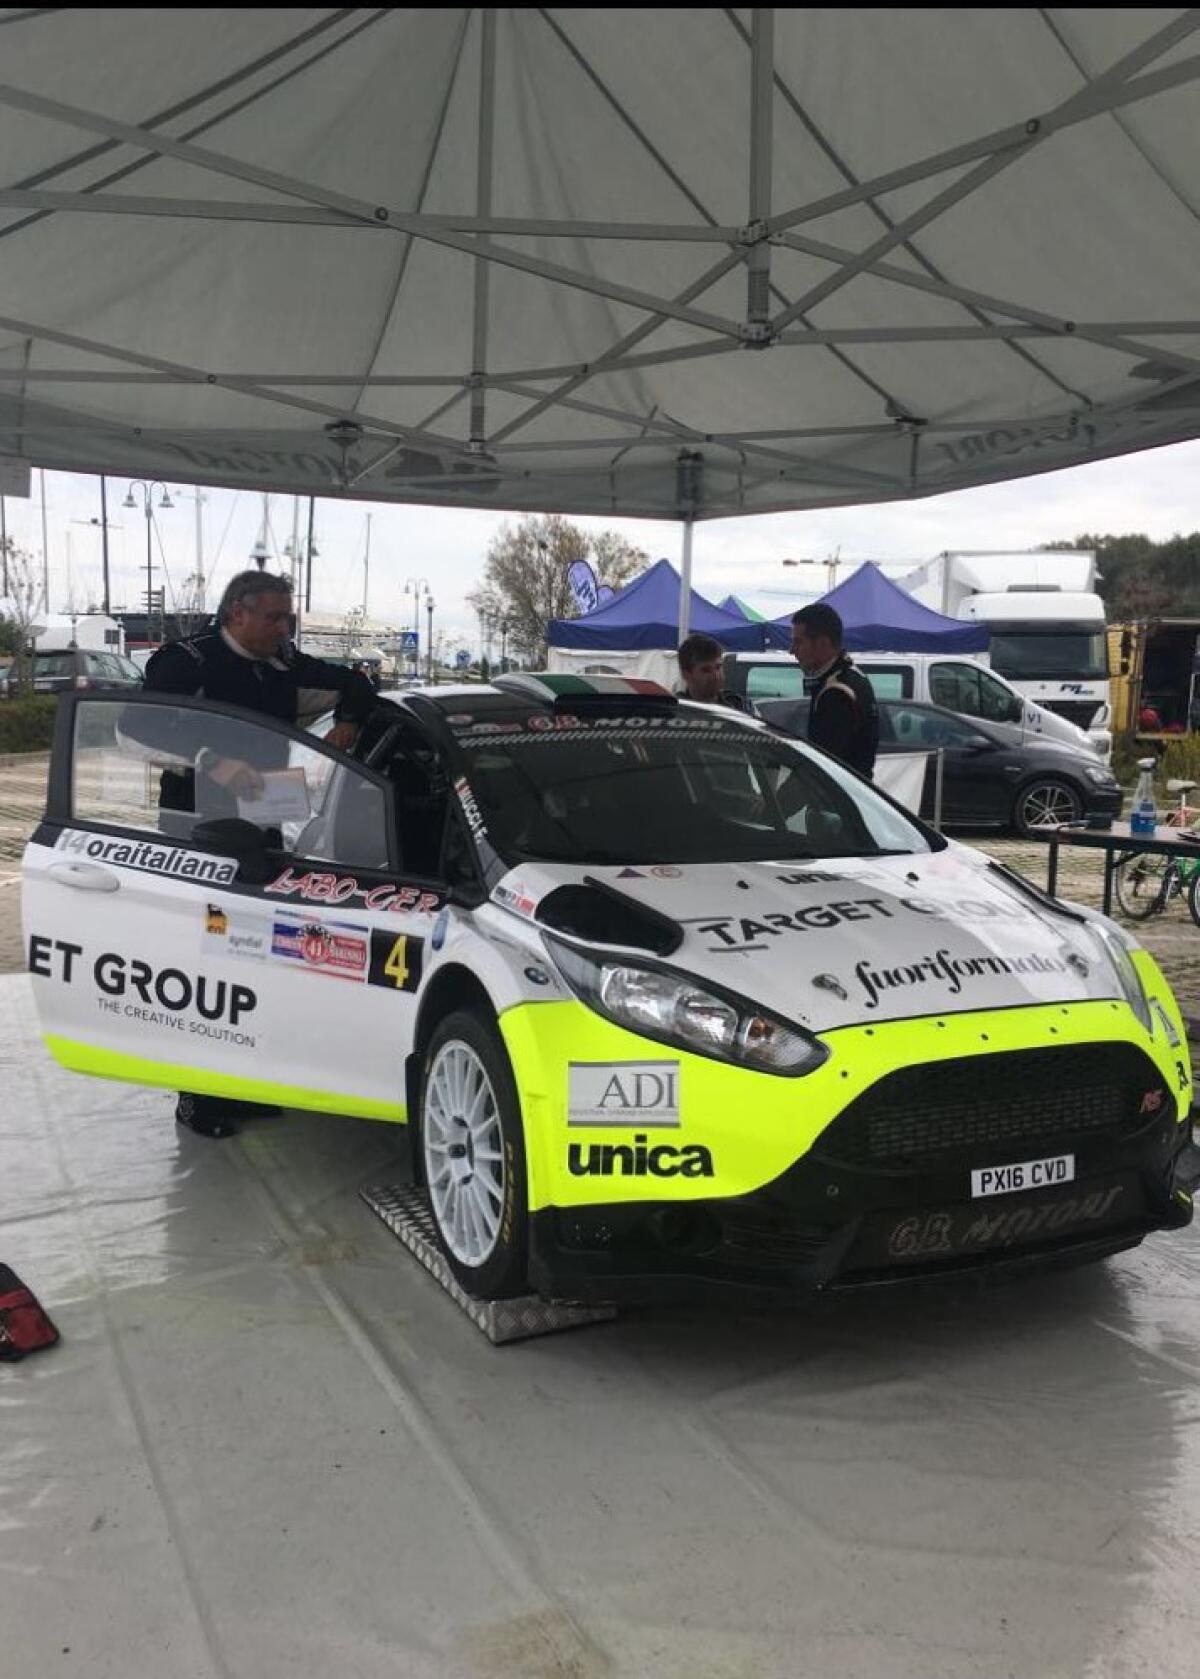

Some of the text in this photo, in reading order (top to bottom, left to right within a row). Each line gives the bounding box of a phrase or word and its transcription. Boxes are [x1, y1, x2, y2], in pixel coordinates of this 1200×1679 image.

[698, 899, 894, 946] TARGET
[28, 934, 258, 1026] ET GROUP
[384, 935, 409, 988] 4
[855, 949, 1065, 1008] fuoriformato
[98, 998, 256, 1048] THE CREATIVE SOLUTION
[598, 1073, 677, 1109] ADI
[568, 1134, 714, 1178] unica
[981, 1159, 1067, 1194] PX16 CVD
